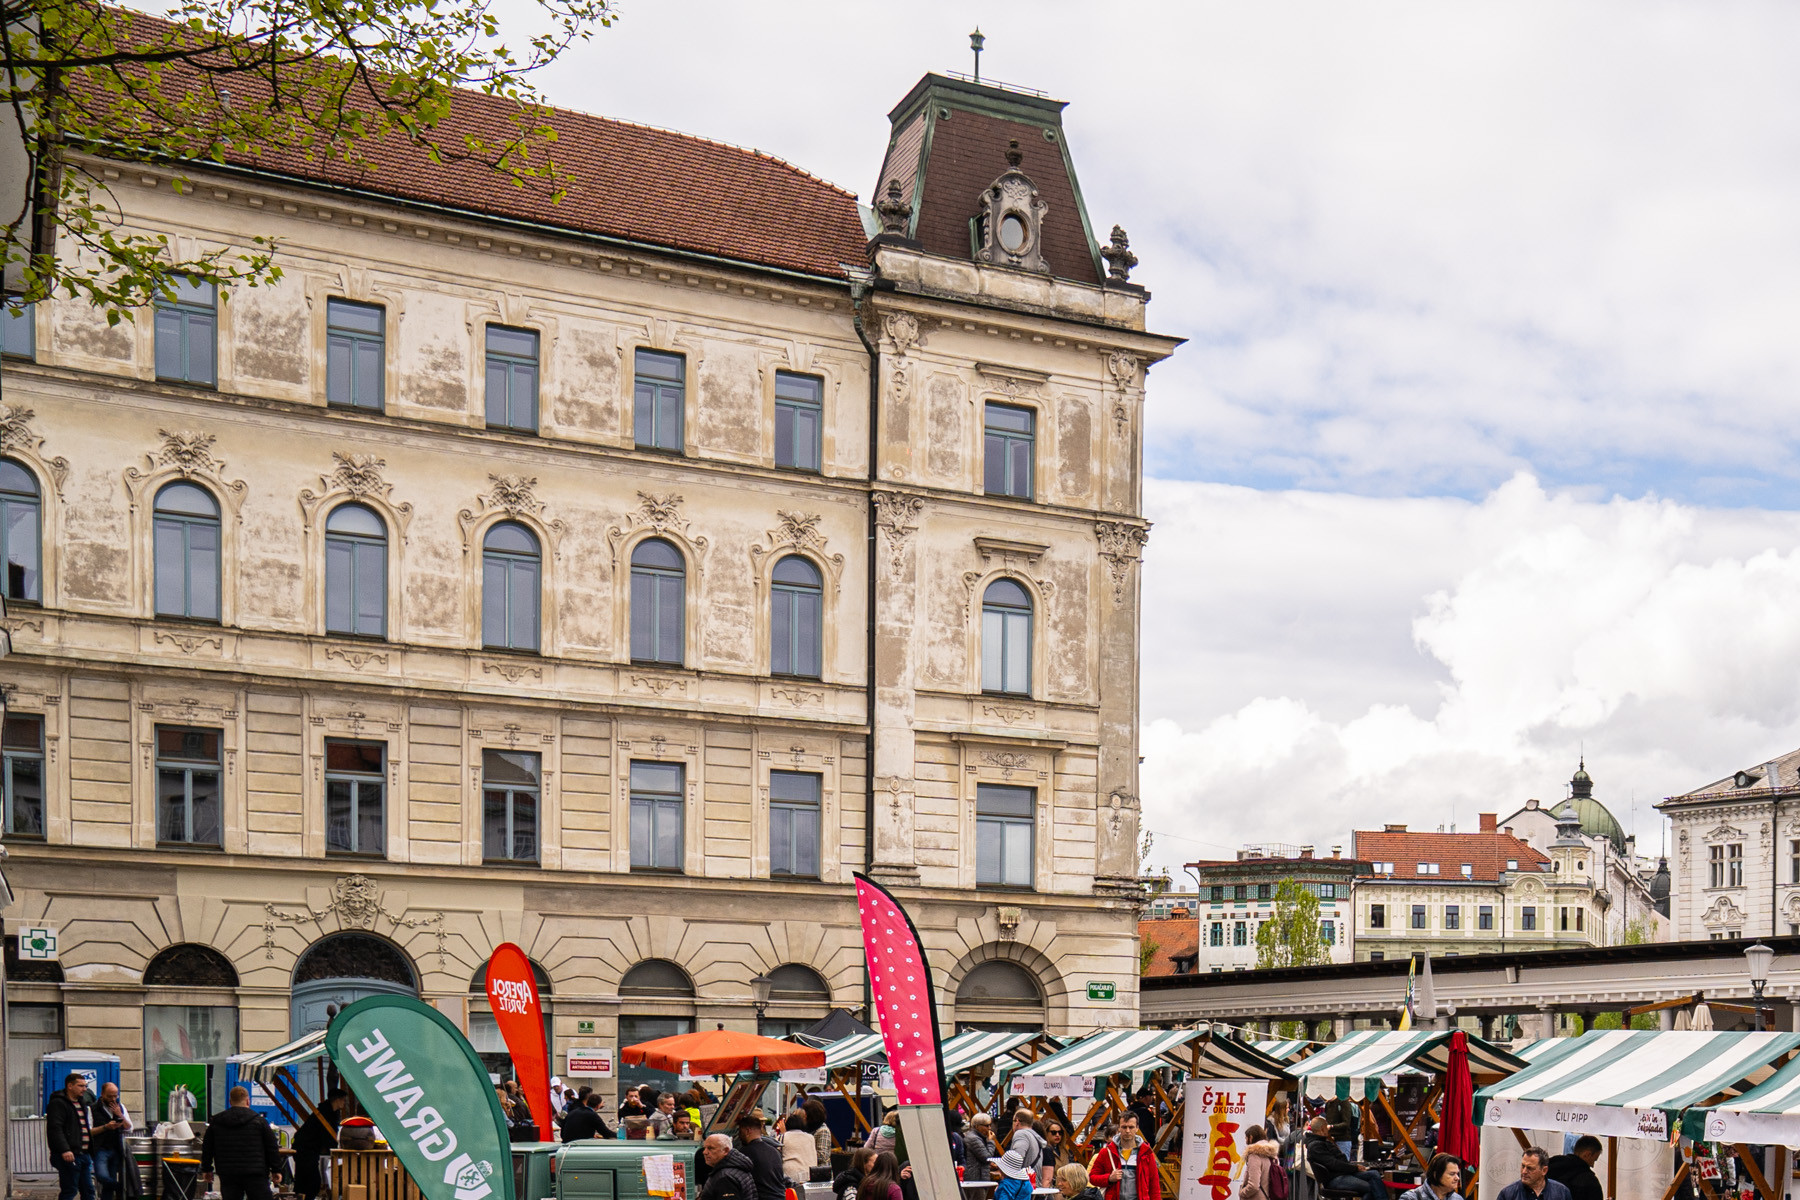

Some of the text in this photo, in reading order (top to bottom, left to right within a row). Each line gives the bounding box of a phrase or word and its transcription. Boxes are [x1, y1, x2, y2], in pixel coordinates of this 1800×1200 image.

[1202, 1086, 1247, 1106] ČILI
[1213, 1106, 1246, 1114] OKUSOM
[1556, 1110, 1589, 1123] ČILI PIPP
